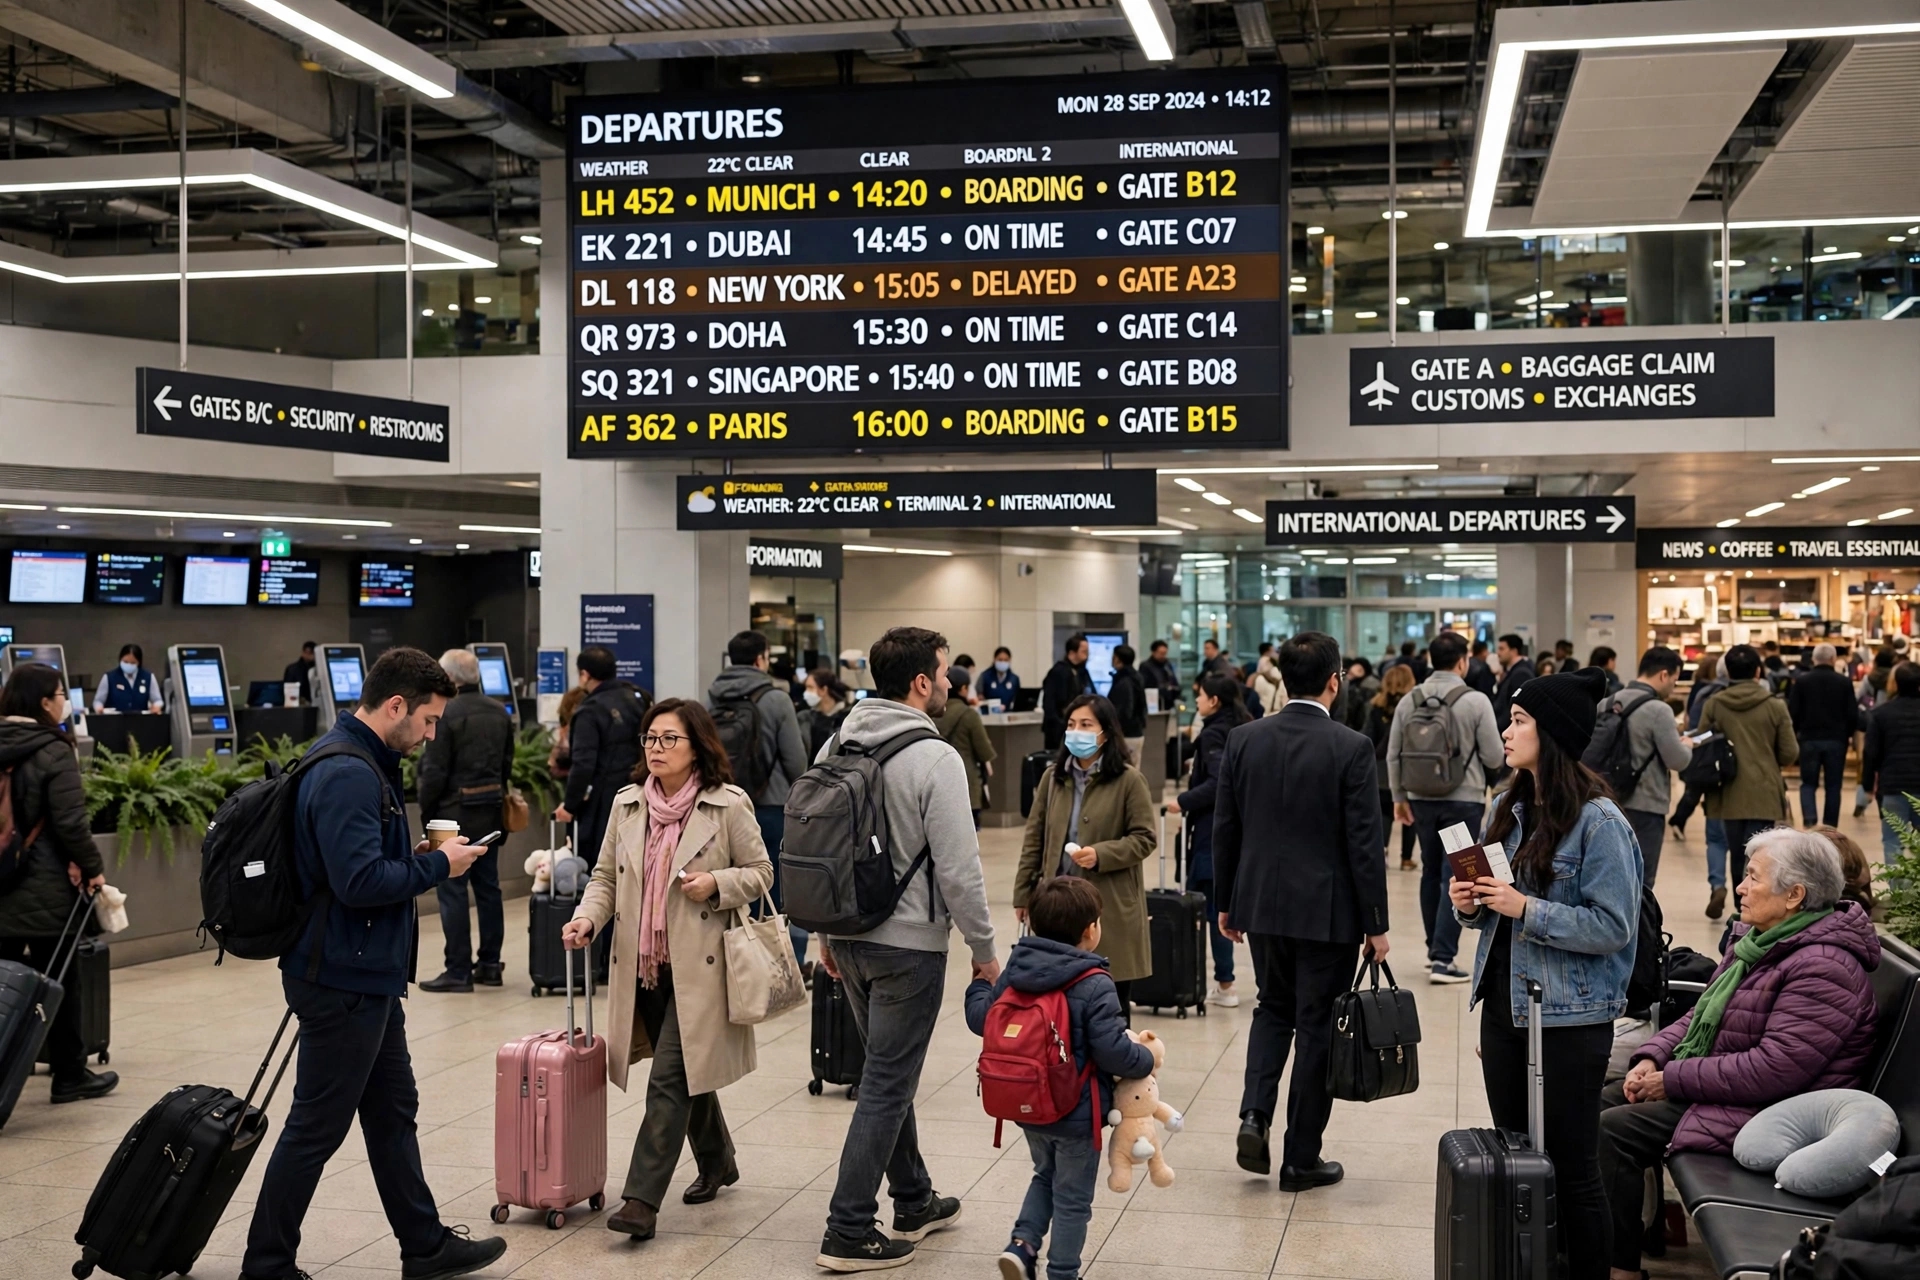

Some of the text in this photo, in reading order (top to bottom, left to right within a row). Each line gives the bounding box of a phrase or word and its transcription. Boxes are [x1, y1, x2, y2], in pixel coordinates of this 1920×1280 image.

[1057, 88, 1271, 114] MON 28 SEP 2024 14:12
[581, 107, 784, 145] DEPARTURES
[579, 160, 649, 178] WEATHER
[744, 155, 794, 172] CLEAR
[859, 151, 910, 168] CLEAR
[1041, 146, 1052, 162] 2
[1119, 139, 1239, 159] INTERNATIONAL
[581, 169, 1237, 217] LH 452 MUNICH 14:20 BOARDING GATE B12
[581, 217, 1237, 262] EK 221 DUBAI 14:45 ON TIME GATE C07
[581, 264, 1237, 307] DL 118 NEW YORK 15:05 DELAYED GATE A23
[580, 311, 1238, 356] QR 973 DOHA 15:30 ON TIME GATE C14
[581, 358, 1238, 401] SQ 321 SINGAPORE 15:40 ON TIME GATE B08
[1411, 351, 1715, 381] GATE A BAGGAGE CLAIM
[1411, 383, 1697, 412] CUSTOMS EXCHANGES
[189, 394, 444, 443] GATES B/C SECURITY RESTROOMS
[580, 405, 1238, 442] AF 362 PARIS 16:00 BOARDING GATE B15
[723, 497, 794, 514] WEATHER:
[833, 496, 879, 513] CLEAR
[896, 495, 970, 512] TERMINAL
[972, 494, 982, 511] 2
[1000, 493, 1116, 511] INTERNATIONAL
[1278, 508, 1587, 534] INTERNATIONAL DEPARTURES
[1662, 541, 1704, 559] NEWS
[1719, 541, 1774, 558] COFFEE
[1789, 540, 1844, 557] TRAVEL
